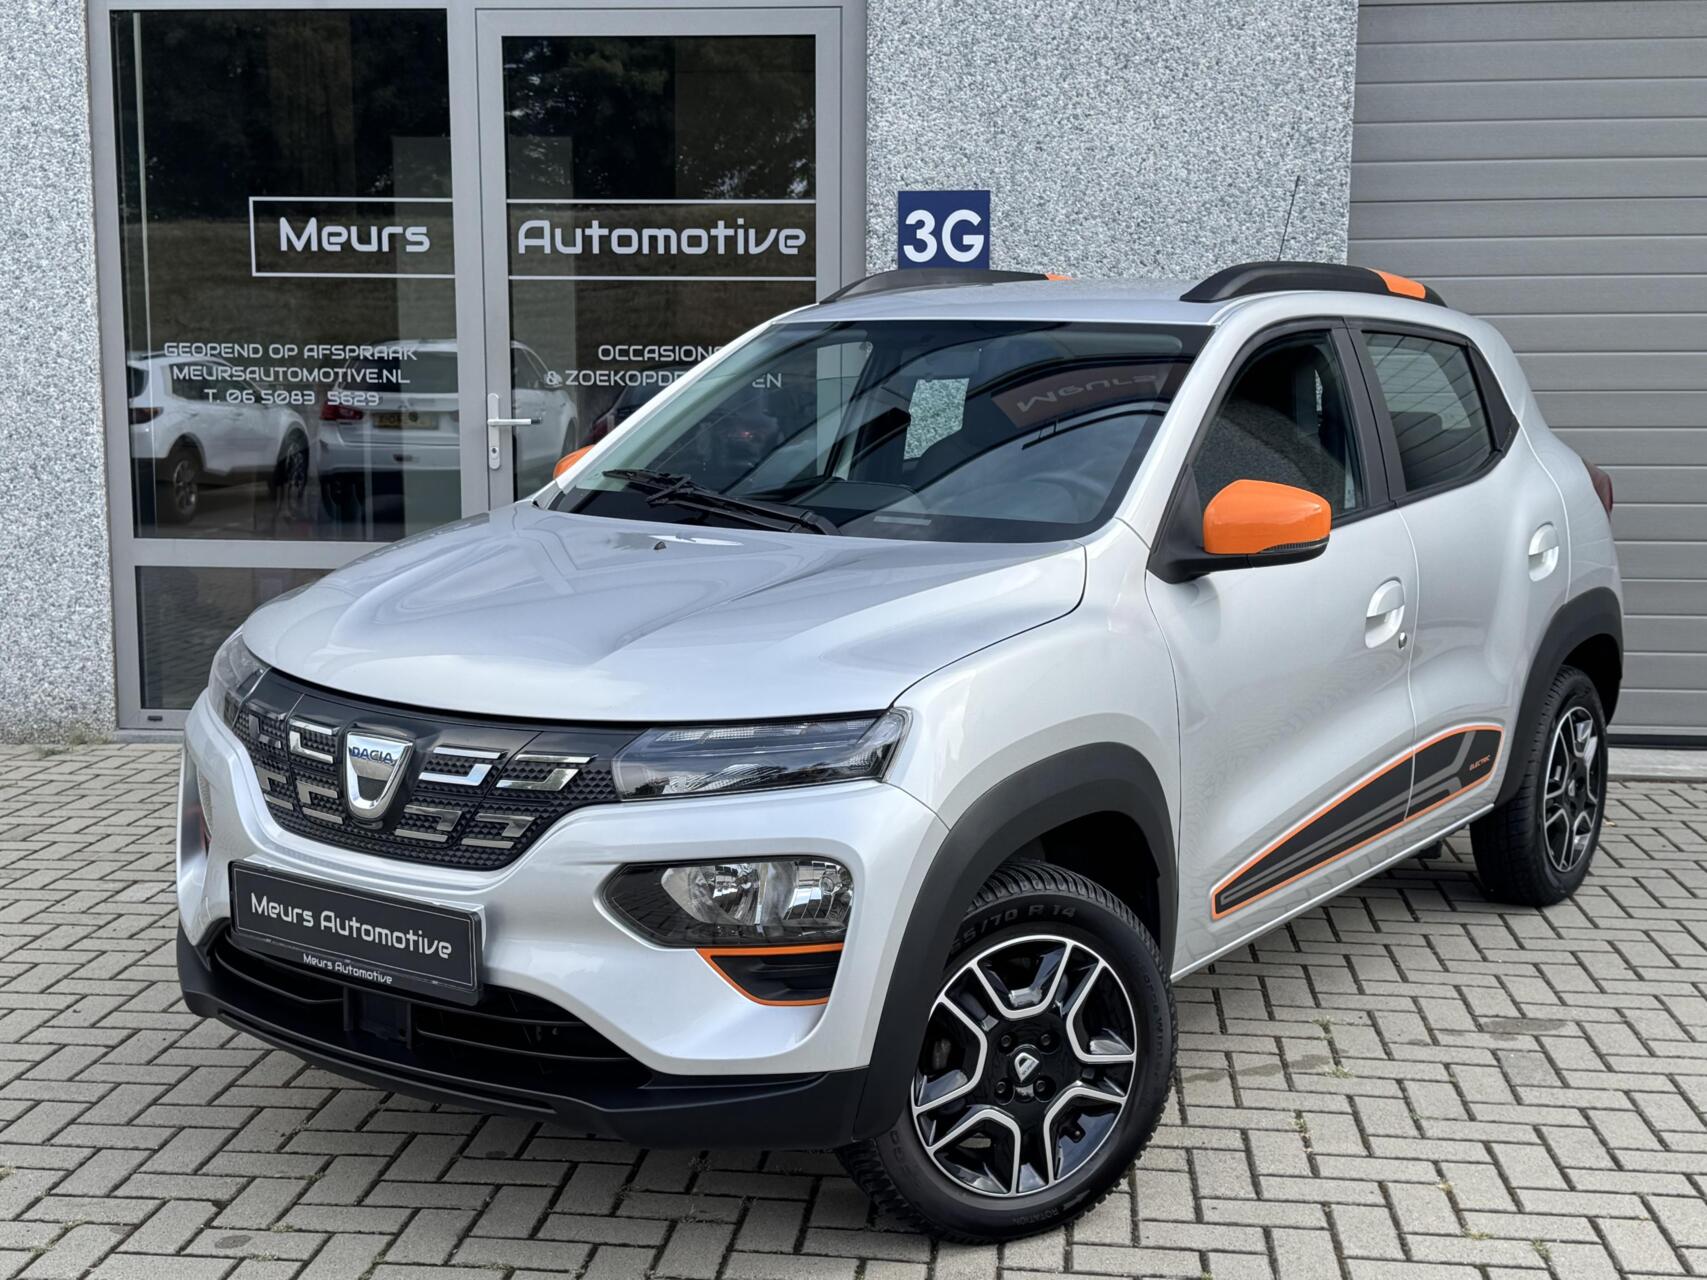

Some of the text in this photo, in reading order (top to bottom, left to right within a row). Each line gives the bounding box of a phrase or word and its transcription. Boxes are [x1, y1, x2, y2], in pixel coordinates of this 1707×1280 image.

[279, 216, 806, 255] Meurs Automotive
[903, 209, 985, 262] 3G
[163, 342, 417, 361] GEOPEND OP AFSPRAAK
[172, 365, 411, 384] MEURSAUTOMOTIVE.NL
[545, 370, 563, 387] &
[203, 388, 380, 406] T. 06 5083 5629
[351, 746, 394, 765] DACIA
[251, 892, 452, 959] Meurs Automotive
[303, 952, 393, 985] Meurs Automotive
